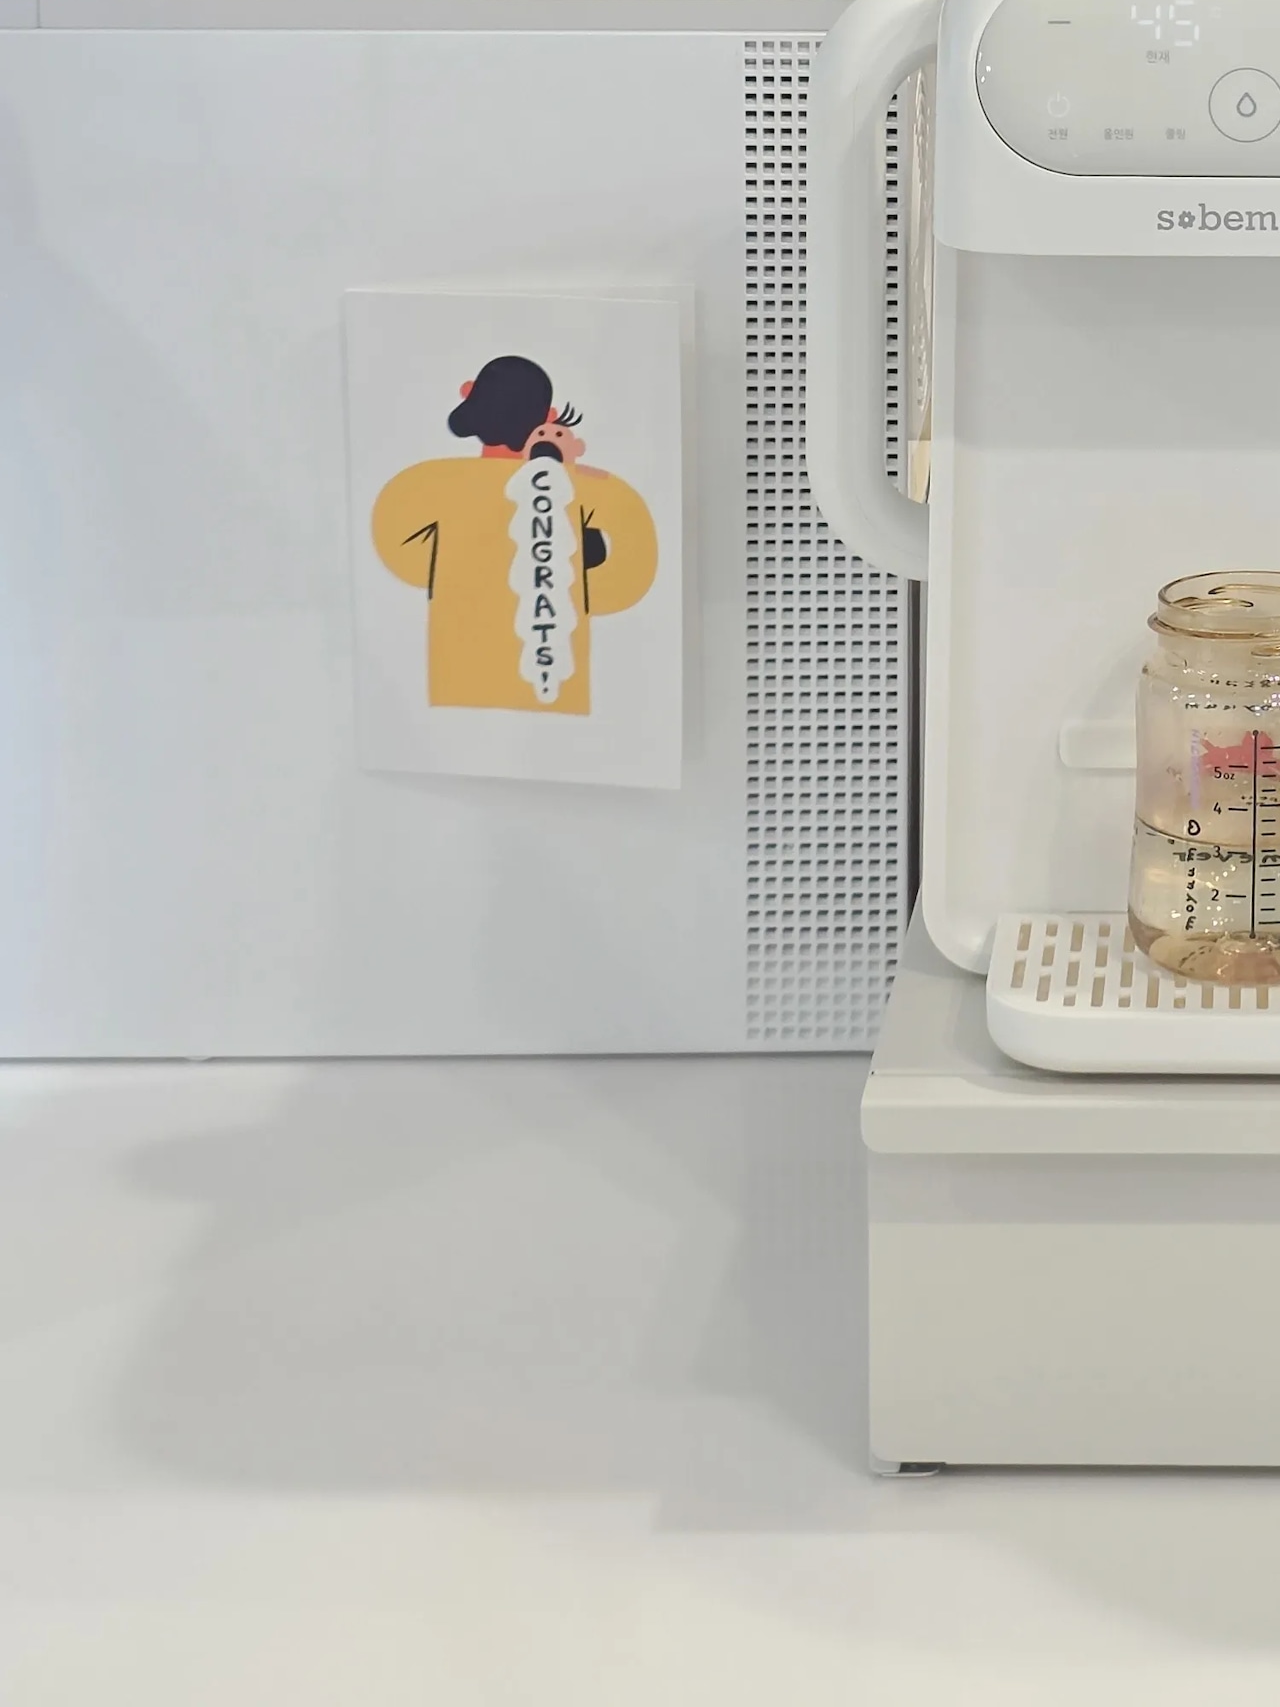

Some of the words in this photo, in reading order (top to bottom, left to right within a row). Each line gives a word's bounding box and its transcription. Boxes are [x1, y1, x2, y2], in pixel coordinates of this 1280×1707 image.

[1130, 0, 1200, 47] 45
[1145, 50, 1170, 65] 현재
[1048, 128, 1068, 141] 전원
[530, 469, 557, 694] CONGRATS!
[1212, 802, 1223, 815] 4
[1212, 845, 1222, 859] 3
[1210, 889, 1220, 902] 2
